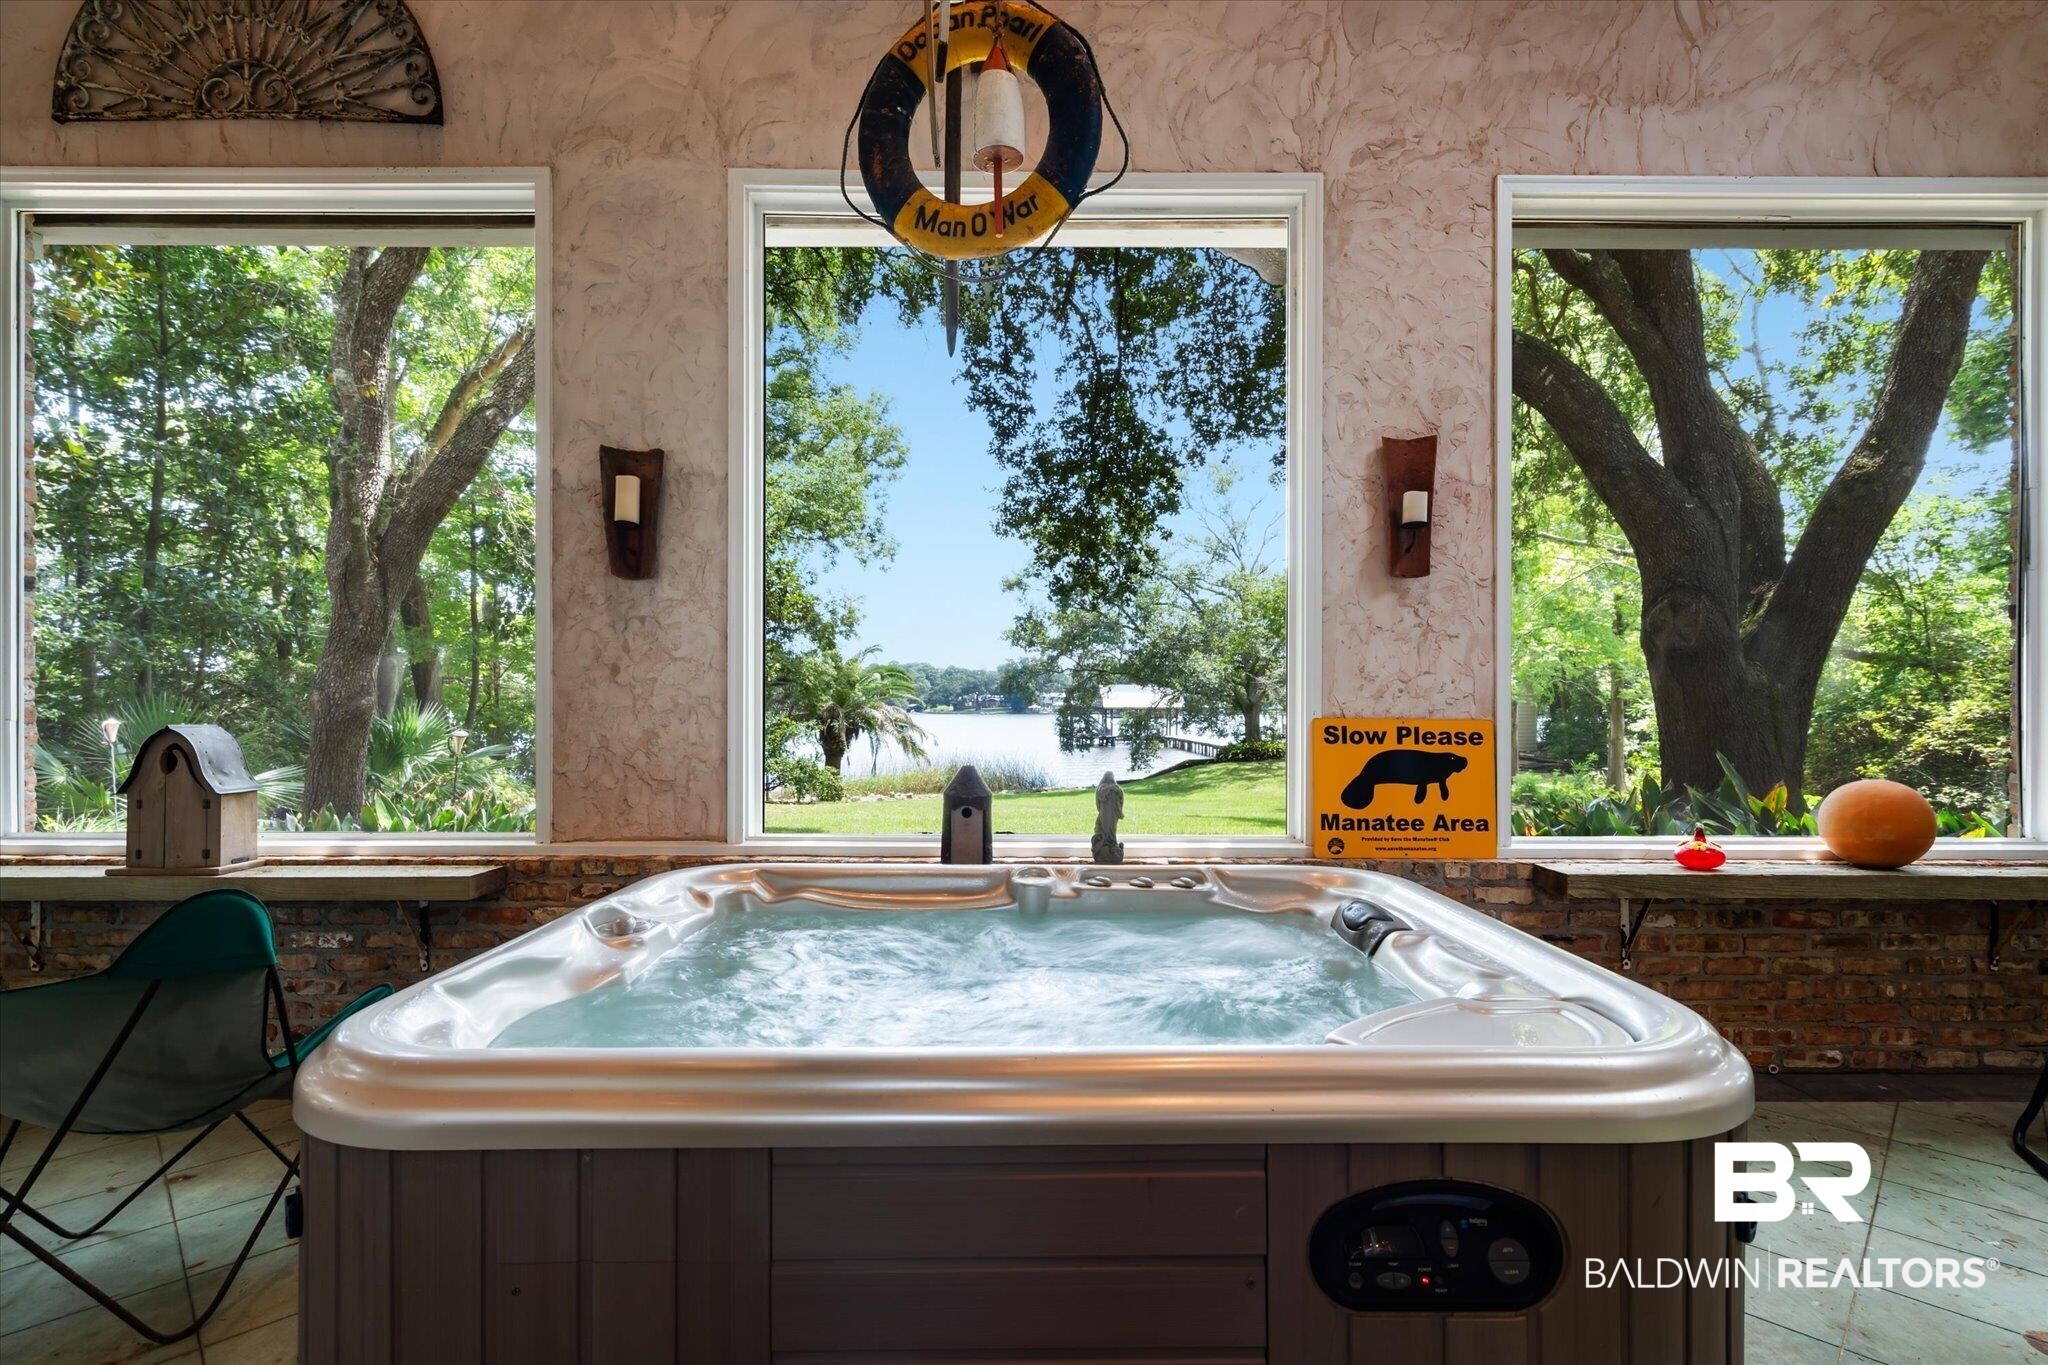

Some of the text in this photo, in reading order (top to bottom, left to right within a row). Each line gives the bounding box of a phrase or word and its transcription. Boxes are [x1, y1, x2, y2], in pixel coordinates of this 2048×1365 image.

[915, 205, 966, 238] Man
[989, 194, 1039, 230] War
[1323, 725, 1484, 746] Slow Please
[1320, 813, 1489, 832] Manatee Area
